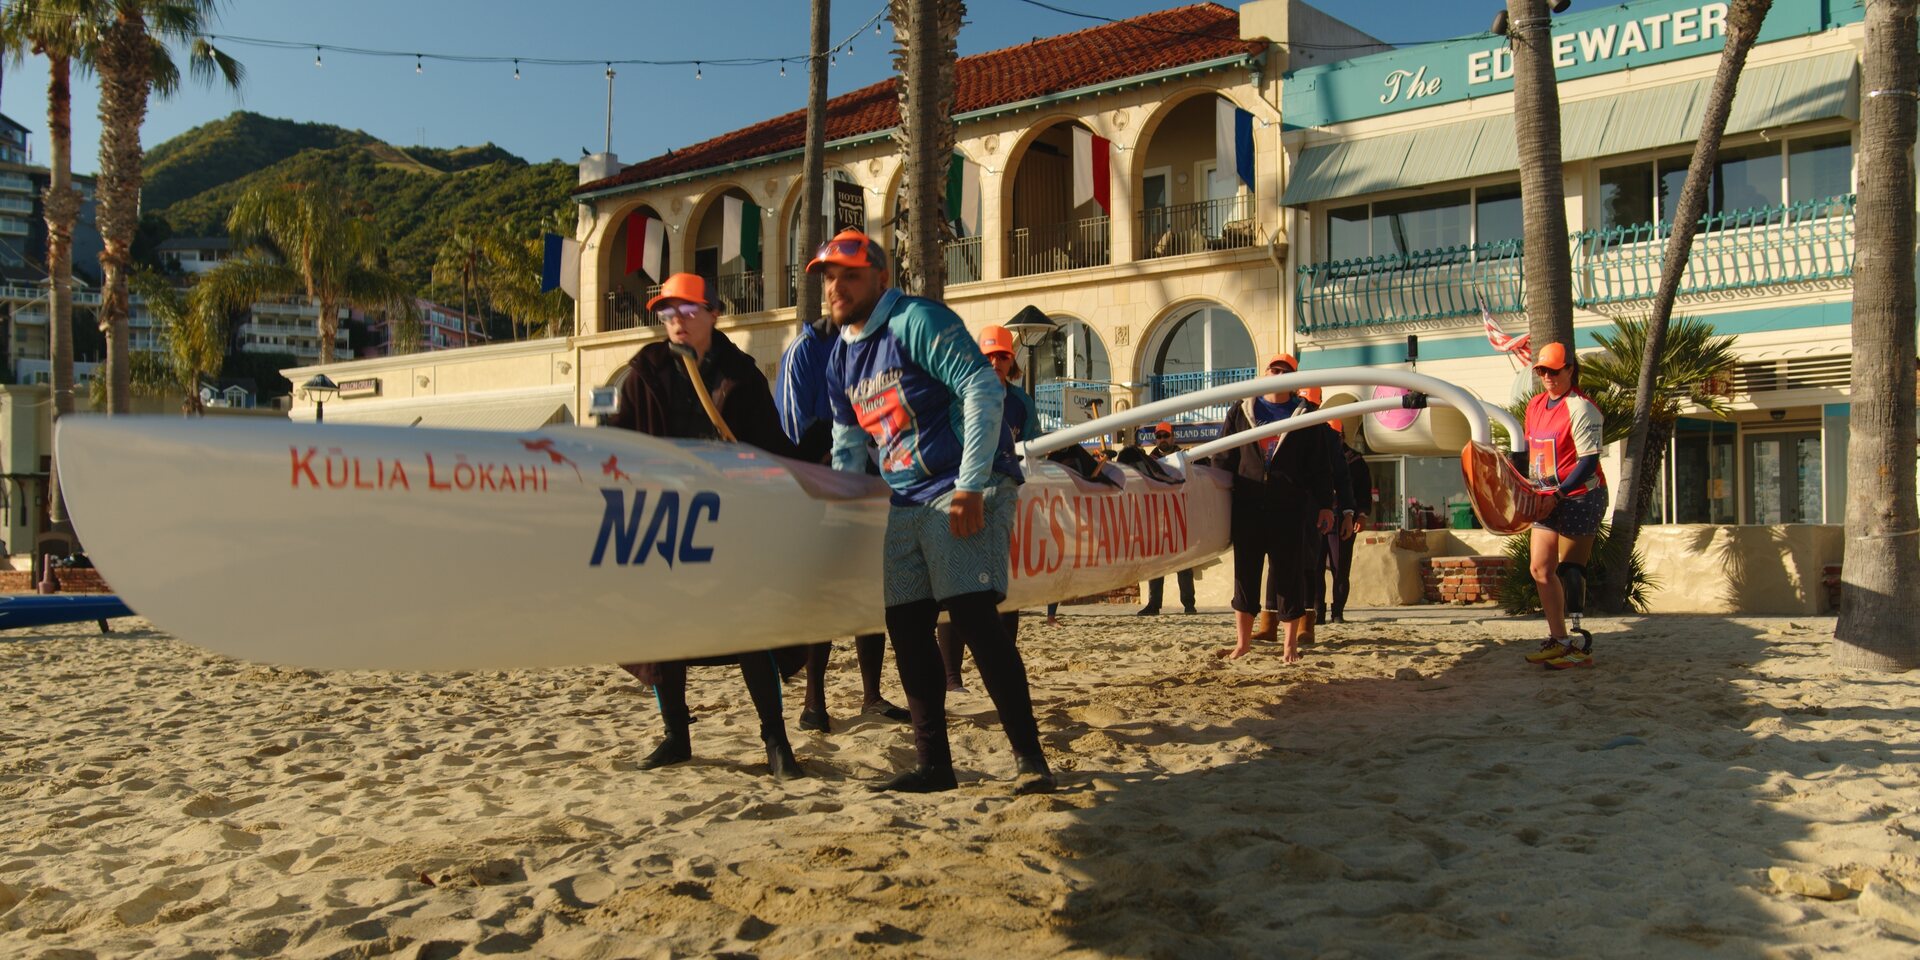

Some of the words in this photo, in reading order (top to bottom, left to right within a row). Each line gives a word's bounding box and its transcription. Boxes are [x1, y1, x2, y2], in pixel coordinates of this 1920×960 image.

[1380, 65, 1442, 104] The
[1468, 2, 1728, 85] EDEWATER
[838, 191, 862, 204] HOTEL
[838, 207, 864, 226] VISTA
[589, 489, 721, 570] NAC
[1009, 487, 1065, 580] NG'S
[1073, 492, 1188, 569] HAWAIIAN
